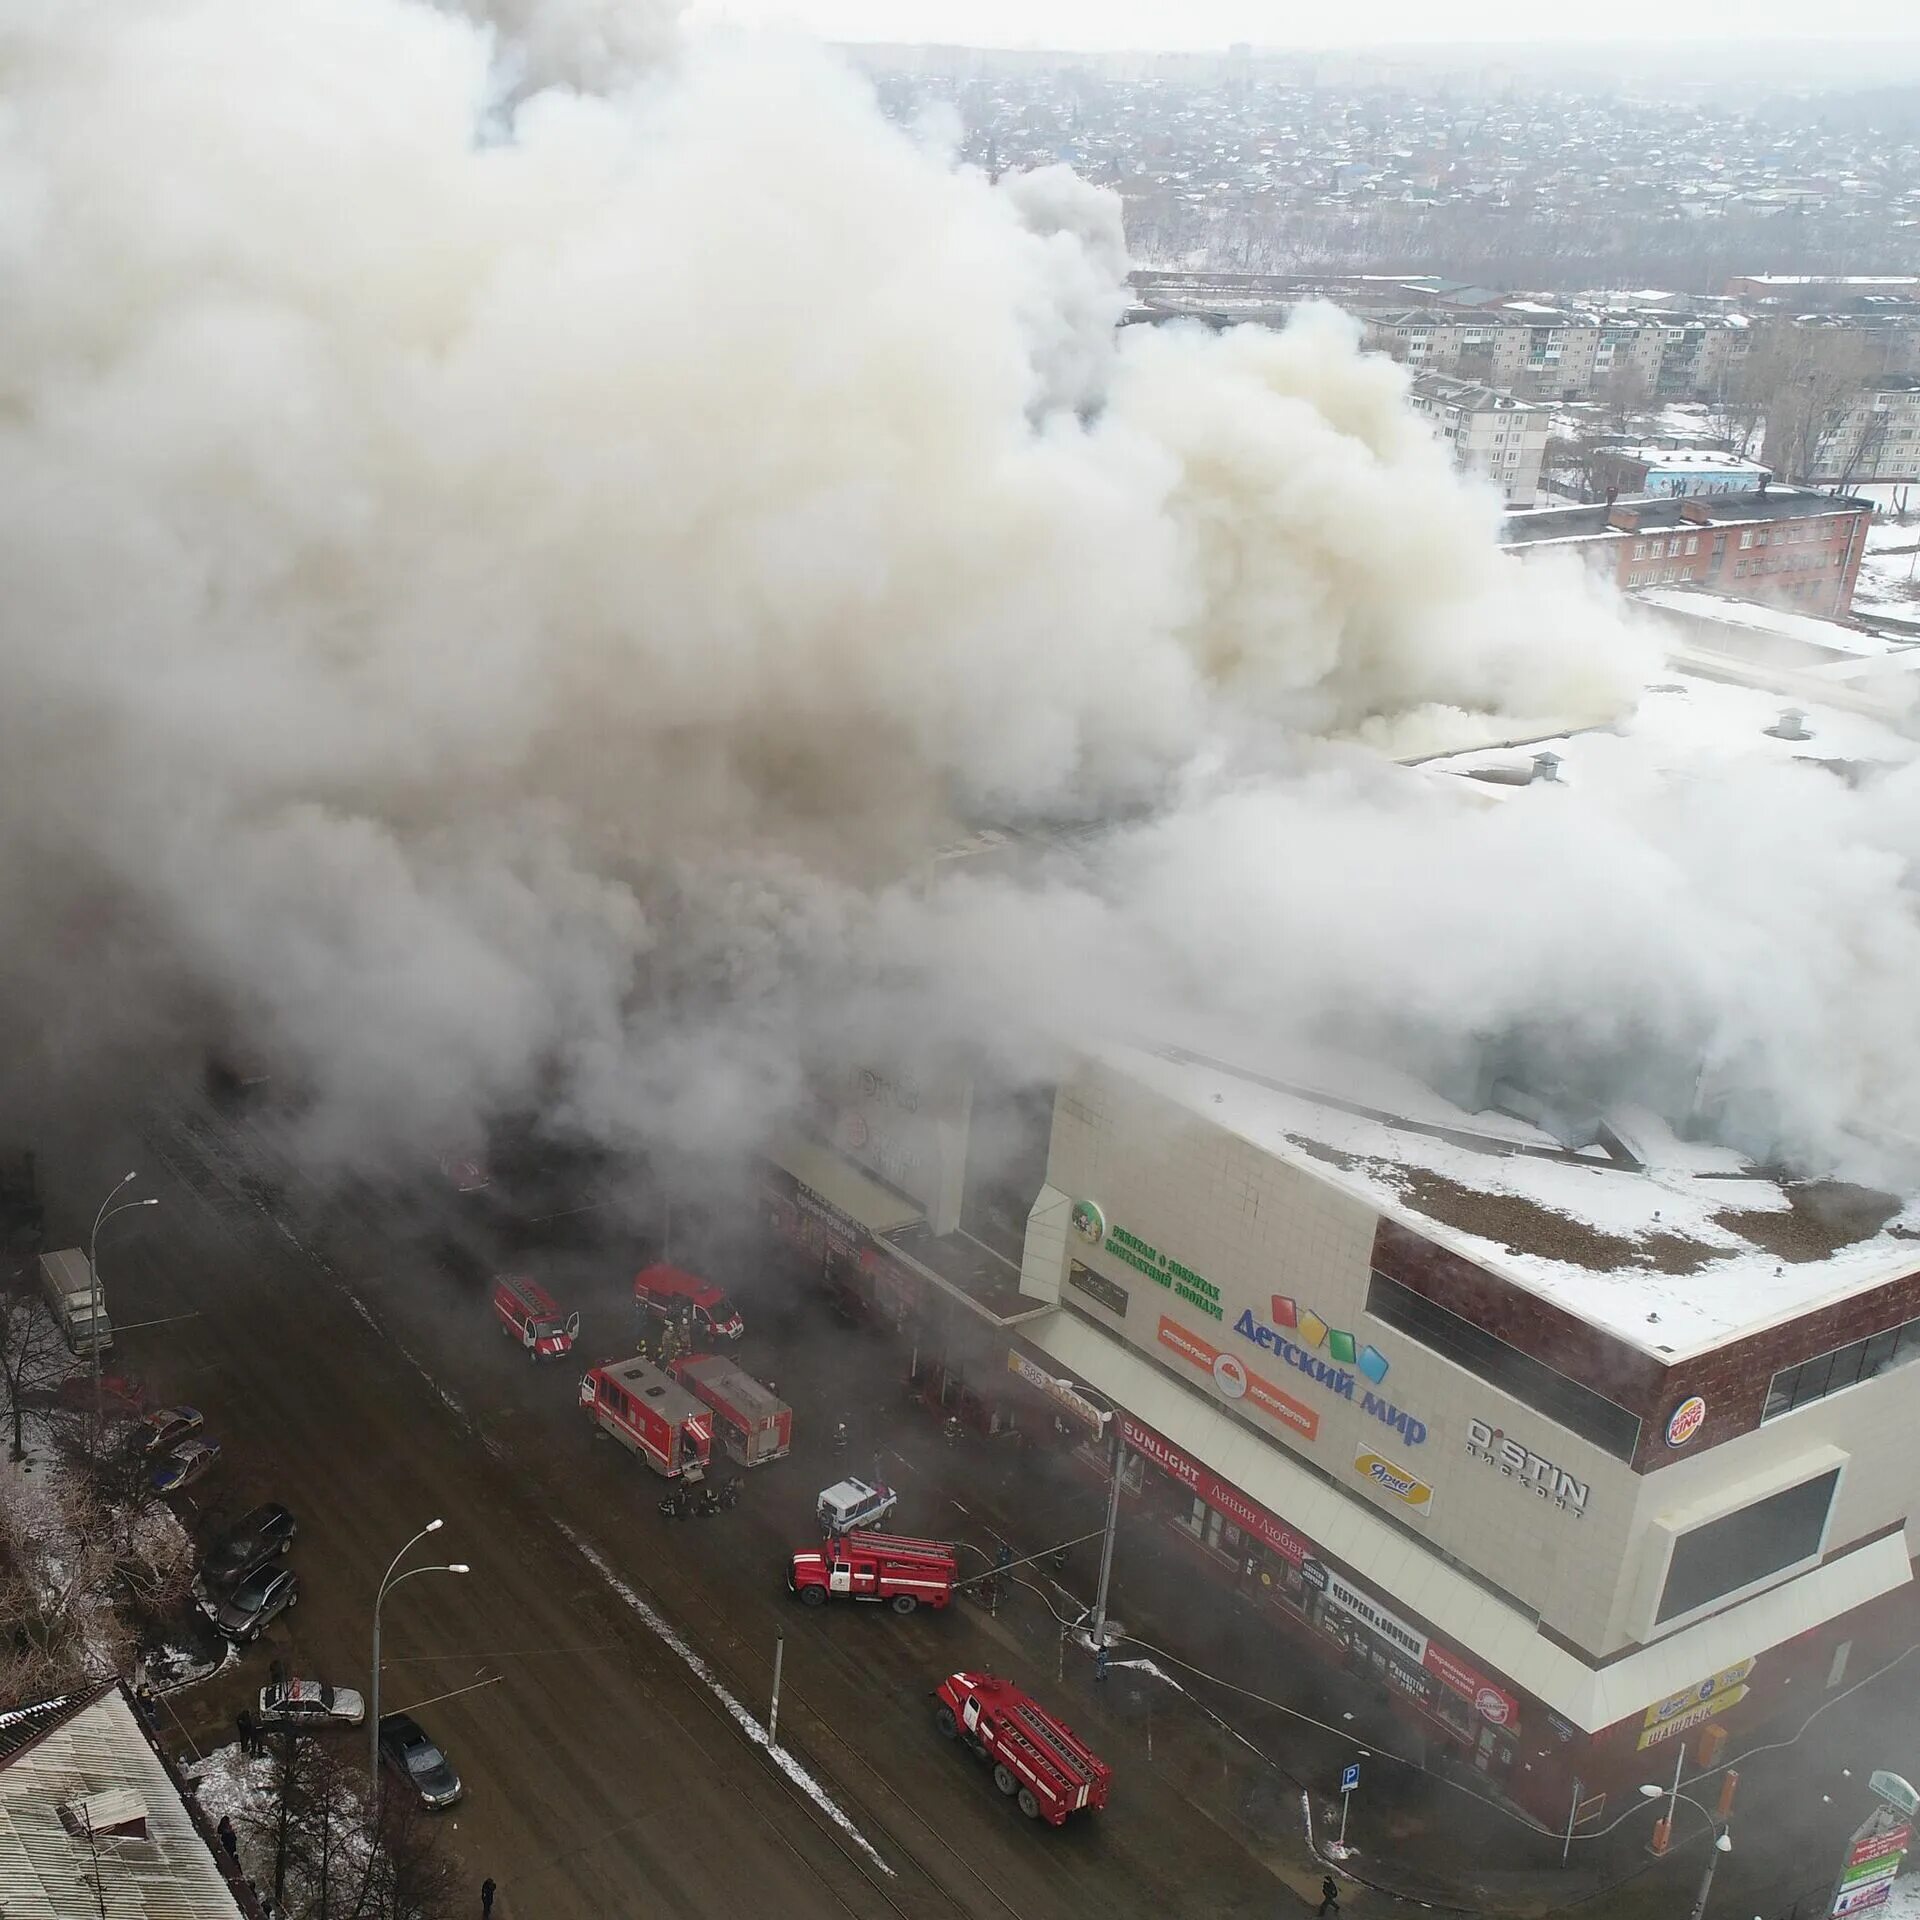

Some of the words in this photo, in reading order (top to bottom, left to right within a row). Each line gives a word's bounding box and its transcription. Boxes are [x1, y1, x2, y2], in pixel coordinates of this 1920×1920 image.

[1175, 1282, 1223, 1321] ЗООПАРК
[1024, 1365, 1042, 1385] 585
[1233, 1309, 1355, 1400] Детский
[1360, 1390, 1427, 1447] мир
[1671, 1402, 1702, 1429] BURGER
[1671, 1410, 1702, 1437] KING
[1124, 1422, 1199, 1482] SUNLIGHT
[1370, 1463, 1416, 1494] Ярче!
[1211, 1485, 1256, 1523] Линии
[1332, 1583, 1375, 1621] ЧЕБУРЕКИ
[1646, 1704, 1713, 1748] ШАШЛЫК
[1346, 1768, 1356, 1783] P
